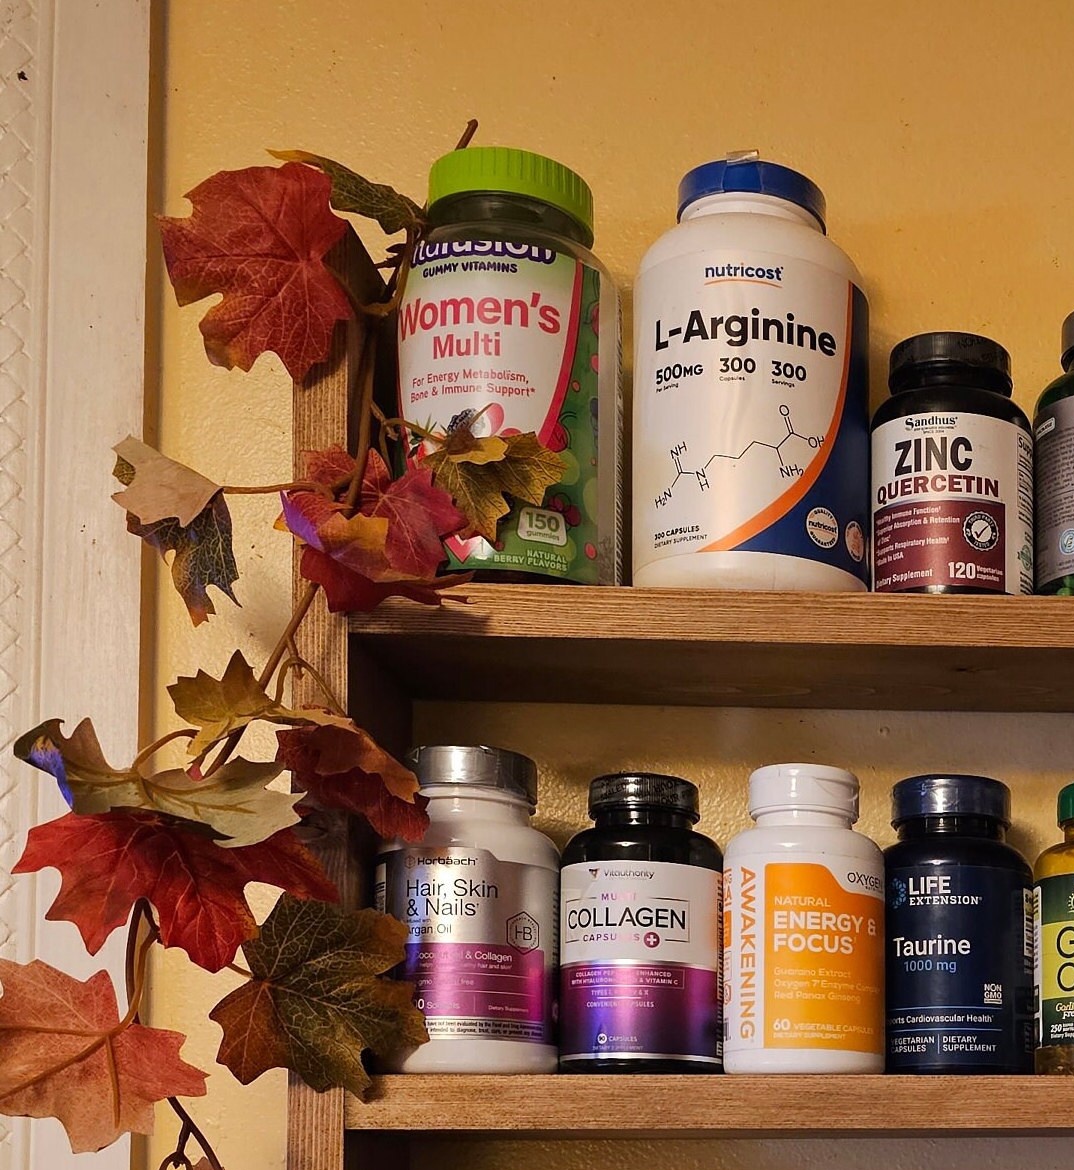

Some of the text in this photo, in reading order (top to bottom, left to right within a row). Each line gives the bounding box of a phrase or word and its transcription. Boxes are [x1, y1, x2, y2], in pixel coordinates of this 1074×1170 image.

[423, 261, 518, 278] GUMMY VITAMINS
[705, 262, 781, 281] nutricost
[398, 293, 561, 342] Women's
[655, 307, 837, 357] L-Arginine
[432, 331, 500, 359] Multi
[656, 363, 704, 385] 500MG
[719, 357, 756, 373] 300
[771, 361, 806, 381] 300
[412, 369, 529, 388] For Energy Metabolism,
[894, 436, 973, 476] ZINC
[877, 474, 999, 505] QUERCETIN
[525, 511, 560, 532] 150
[407, 879, 498, 898] Hair, Skin
[909, 876, 951, 895] LIFE
[774, 896, 831, 907] NATURAL
[909, 896, 979, 906] EXTENSION
[568, 907, 685, 930] COLLAGEN
[774, 911, 877, 936] ENERGY &
[740, 866, 756, 1039] AWAKENING
[774, 934, 853, 954] FOCUS
[893, 935, 971, 957] Taurine
[904, 960, 957, 973] 1000 mg
